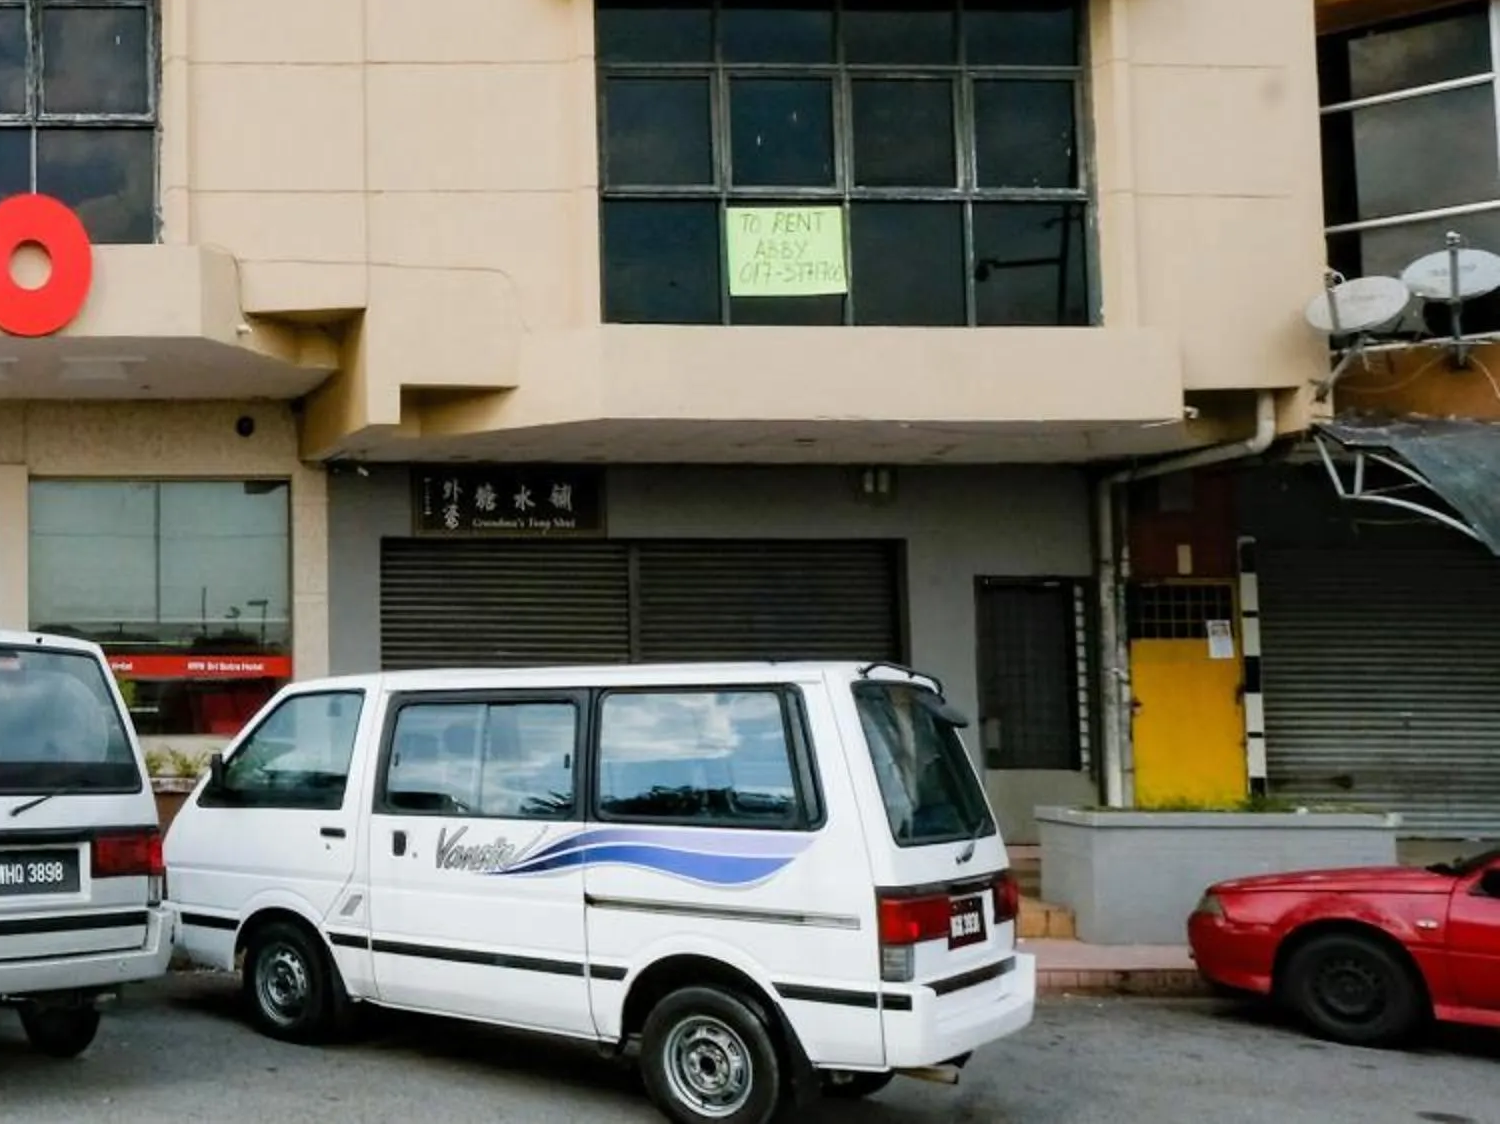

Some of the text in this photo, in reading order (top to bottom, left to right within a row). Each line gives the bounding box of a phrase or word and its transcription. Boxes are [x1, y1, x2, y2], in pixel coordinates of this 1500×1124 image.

[739, 210, 826, 235] TO RENT
[27, 861, 63, 883] 3898
